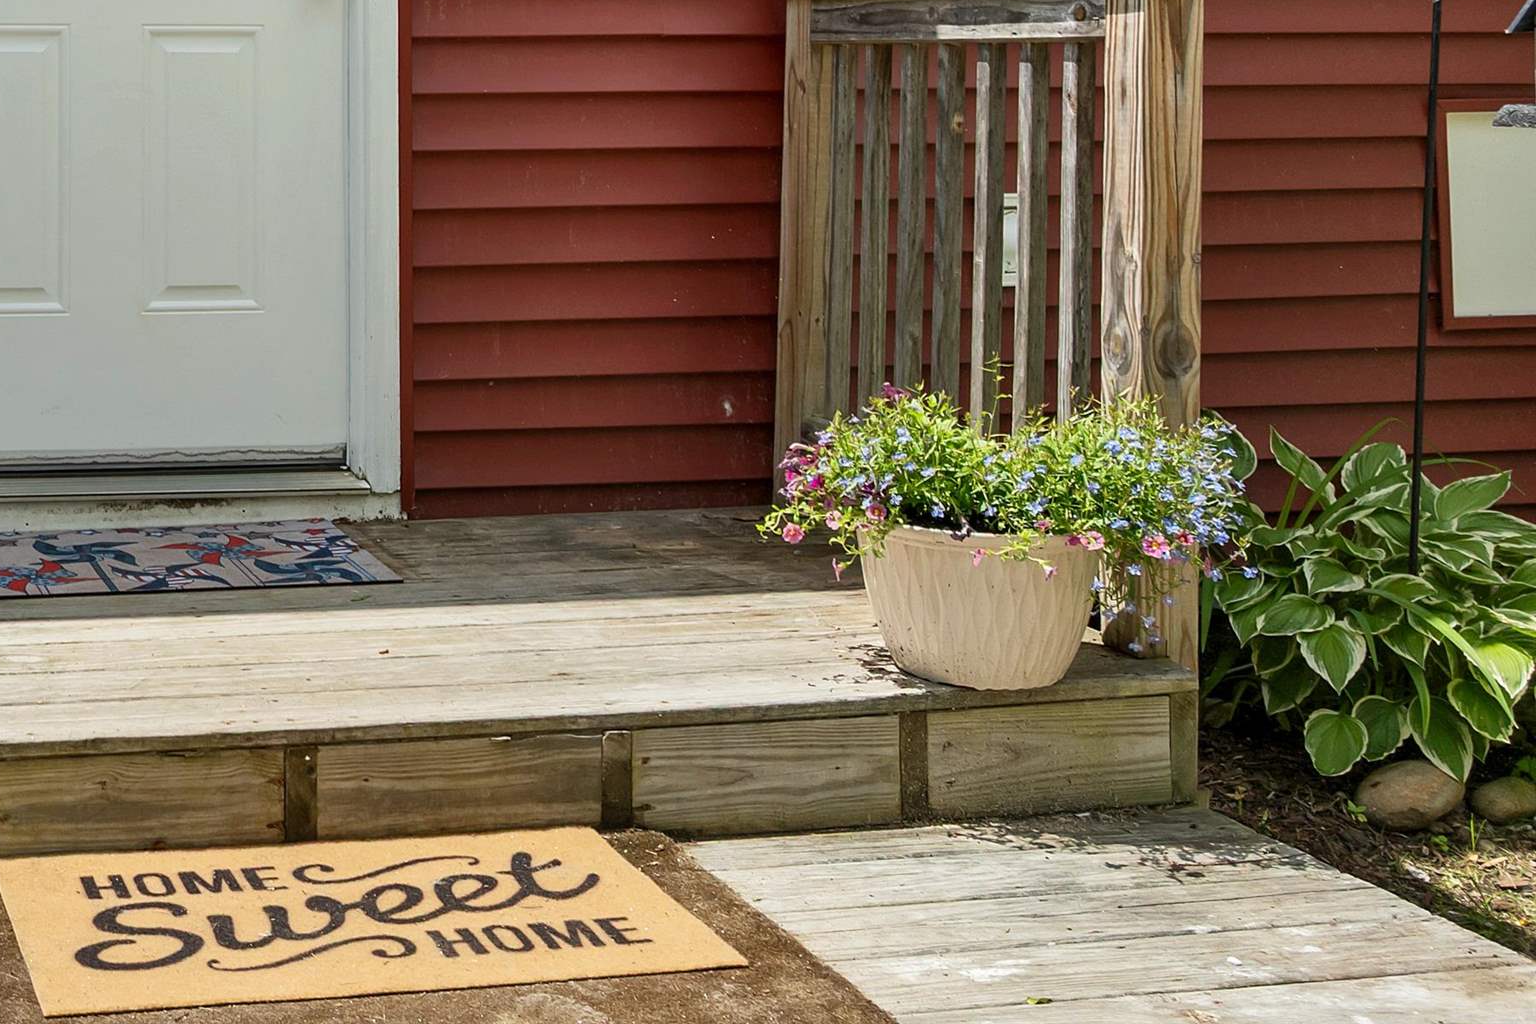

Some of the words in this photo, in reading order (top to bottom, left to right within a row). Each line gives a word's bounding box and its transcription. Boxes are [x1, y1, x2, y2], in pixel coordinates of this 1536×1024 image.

[80, 866, 288, 900] HOME
[74, 851, 600, 970] Sweet
[425, 916, 653, 958] HOME
